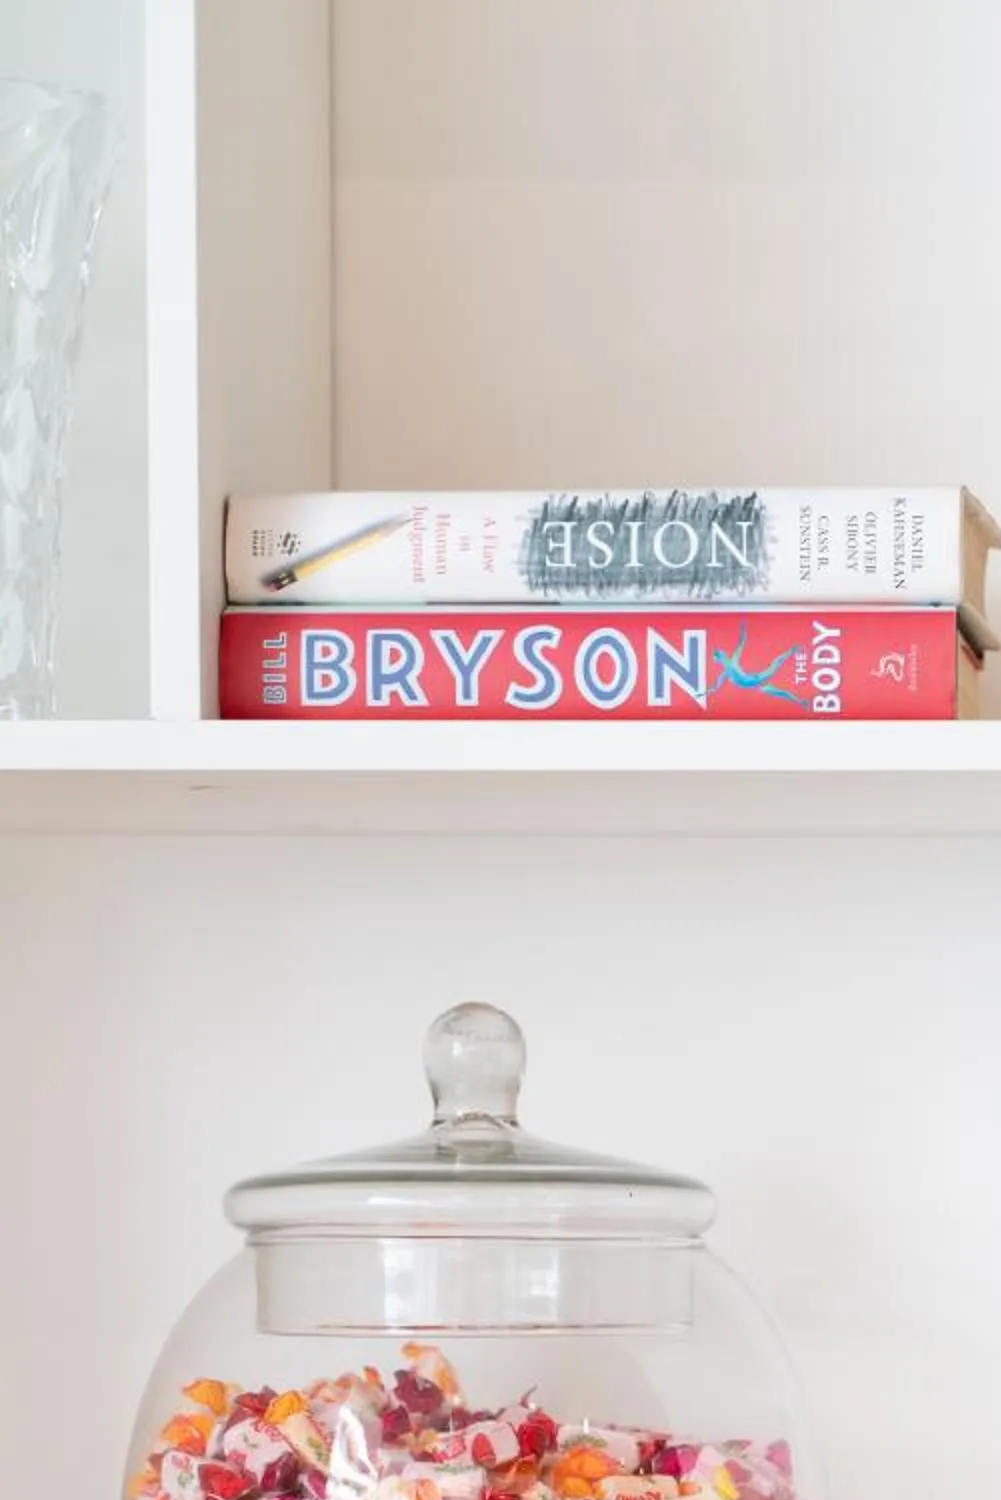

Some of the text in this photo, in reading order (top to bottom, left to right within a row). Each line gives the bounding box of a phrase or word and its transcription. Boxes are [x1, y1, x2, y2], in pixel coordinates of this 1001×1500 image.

[436, 513, 451, 576] Human
[543, 520, 754, 569] NOISE
[799, 504, 812, 582] SUNSTEIN
[817, 515, 830, 571] CASS R.
[846, 514, 859, 571] SIBONY
[864, 511, 878, 575] OLIVIER
[893, 497, 907, 590] KAHNEMAN
[911, 514, 925, 574] DANIEL
[262, 631, 287, 704] BILL
[300, 624, 707, 710] BRYSON
[794, 643, 809, 684] THE
[812, 620, 841, 713] BODY
